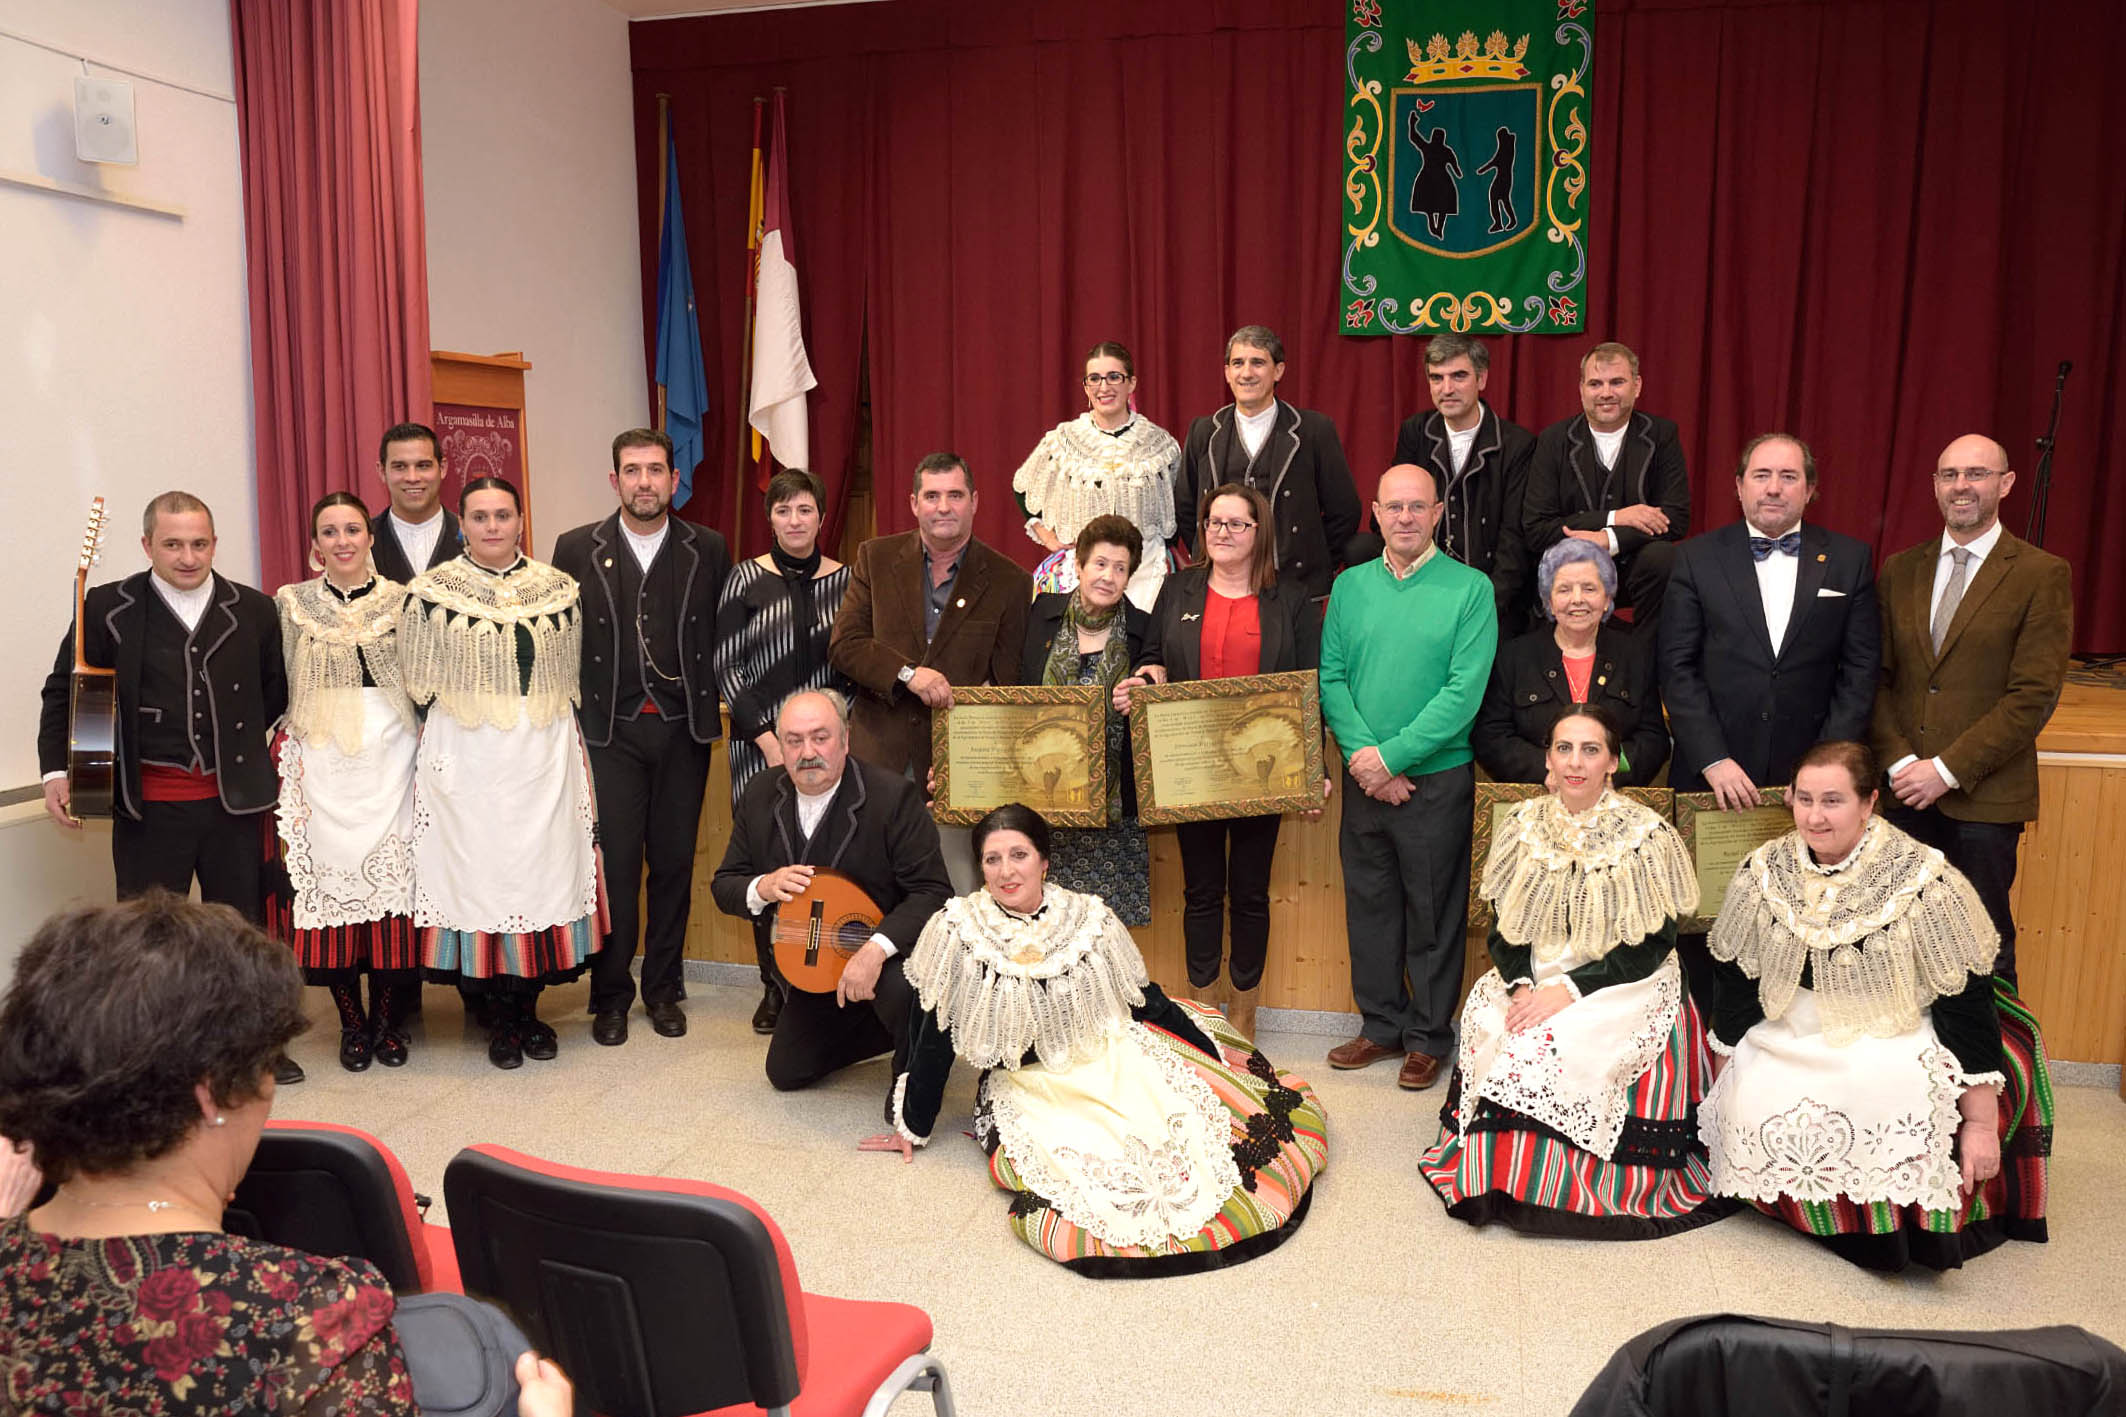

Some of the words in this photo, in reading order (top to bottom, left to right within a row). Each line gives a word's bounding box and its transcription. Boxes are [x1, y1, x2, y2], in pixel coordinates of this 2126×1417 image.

[437, 412, 484, 430] Argamasilla
[486, 414, 495, 428] de
[497, 415, 514, 429] Alba
